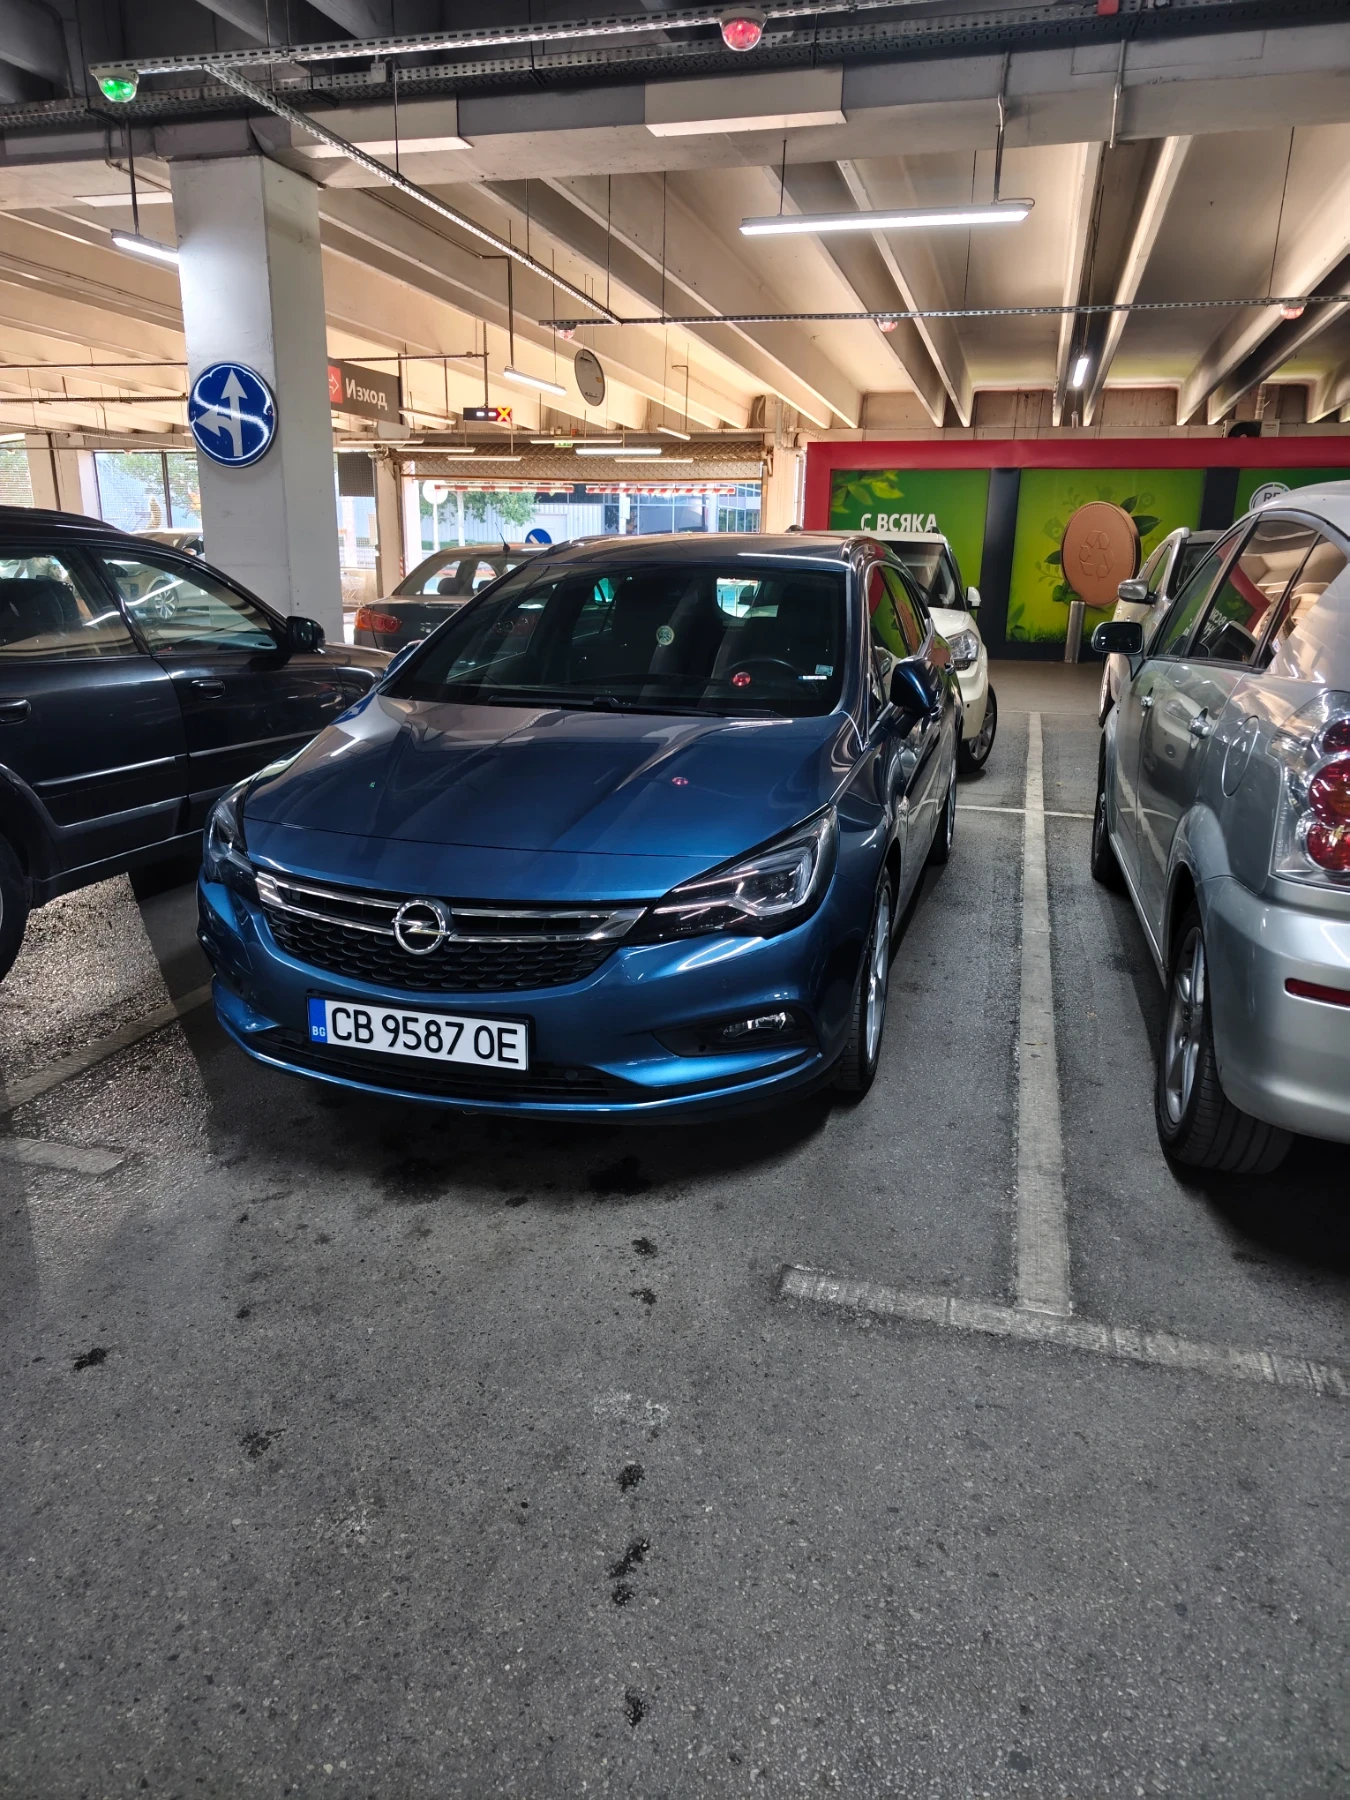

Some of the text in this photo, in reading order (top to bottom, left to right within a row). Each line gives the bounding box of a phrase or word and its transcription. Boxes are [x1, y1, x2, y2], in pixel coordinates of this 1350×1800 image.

[345, 377, 388, 411] Изход
[876, 513, 937, 533] ВСЯКА
[312, 1025, 326, 1037] BG
[331, 1007, 374, 1043] CB
[381, 1014, 464, 1055] 9587
